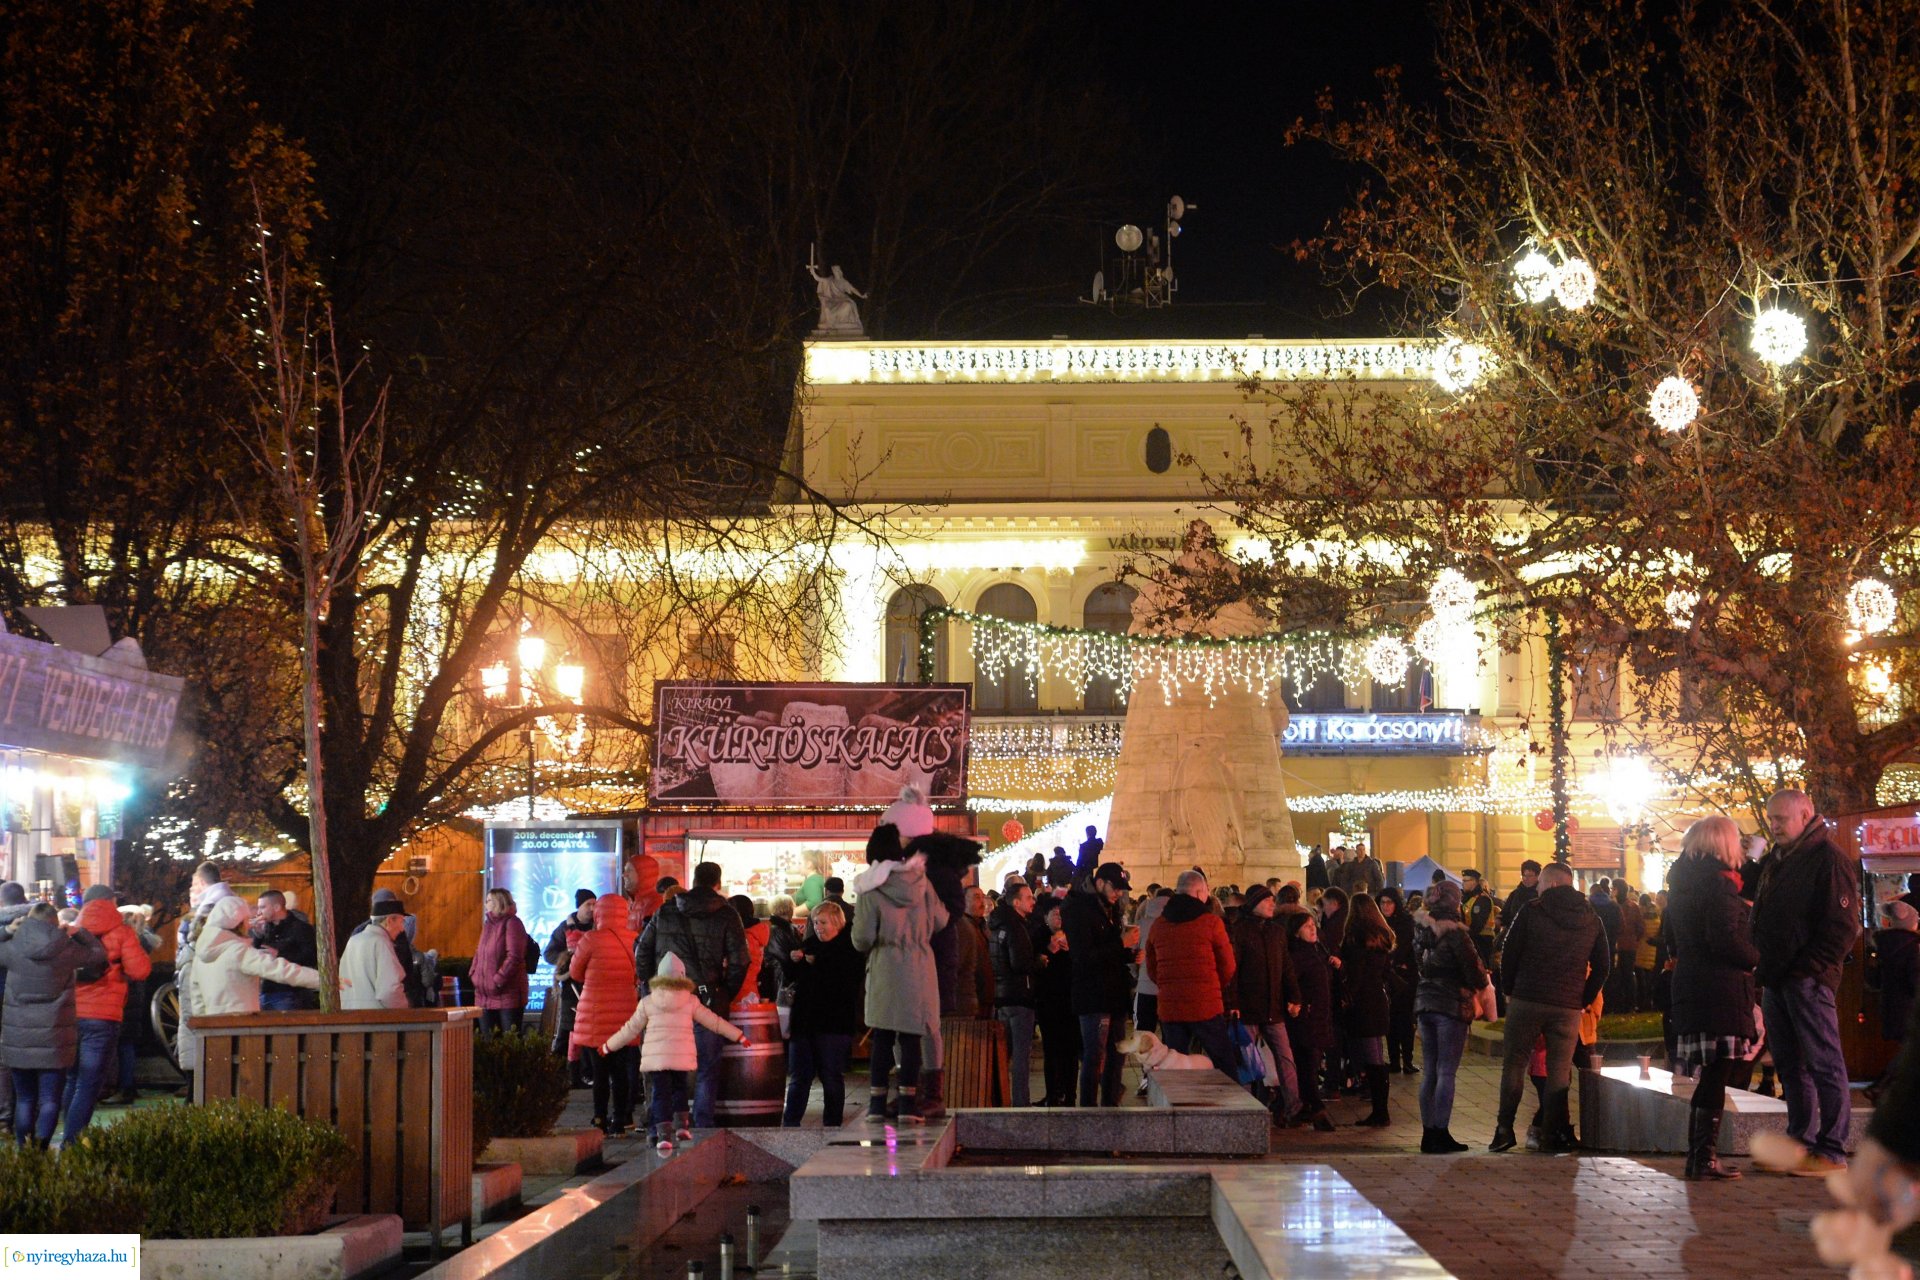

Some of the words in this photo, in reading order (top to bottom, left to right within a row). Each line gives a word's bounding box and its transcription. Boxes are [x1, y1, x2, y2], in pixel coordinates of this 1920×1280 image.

[1283, 717, 1318, 741] ott
[1327, 714, 1462, 744] Karácsonyt!
[514, 831, 538, 840] 2019.
[585, 831, 598, 840] 31.
[522, 840, 549, 849] 20.00
